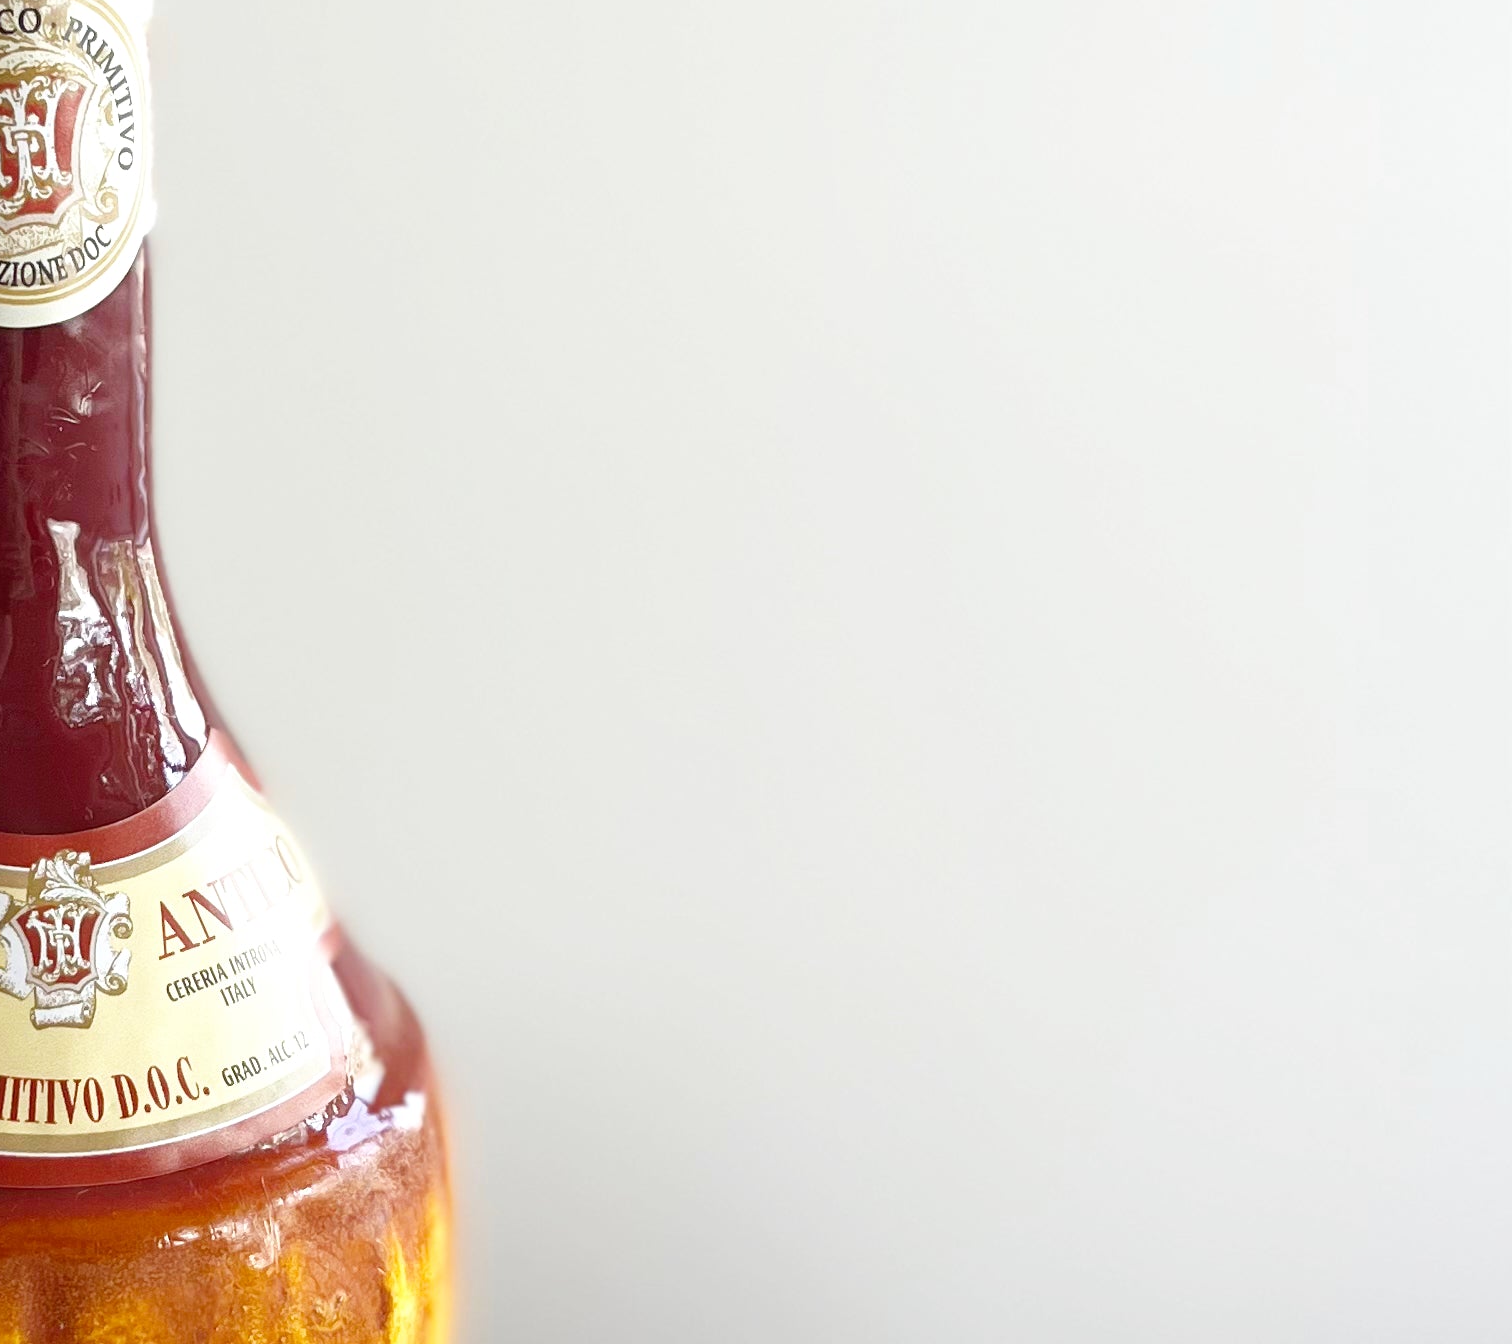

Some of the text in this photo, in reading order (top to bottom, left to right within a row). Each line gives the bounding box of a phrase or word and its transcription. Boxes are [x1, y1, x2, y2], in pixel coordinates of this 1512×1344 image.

[61, 16, 136, 172] PRIMITIVO
[72, 224, 112, 274] DOC
[158, 834, 303, 961] ANTIO
[166, 962, 229, 1002] CERERIA
[219, 976, 257, 1007] ITALY
[110, 1055, 211, 1120] D.O.C.
[220, 1055, 268, 1088] GRAD.
[268, 1040, 295, 1068] ALC.
